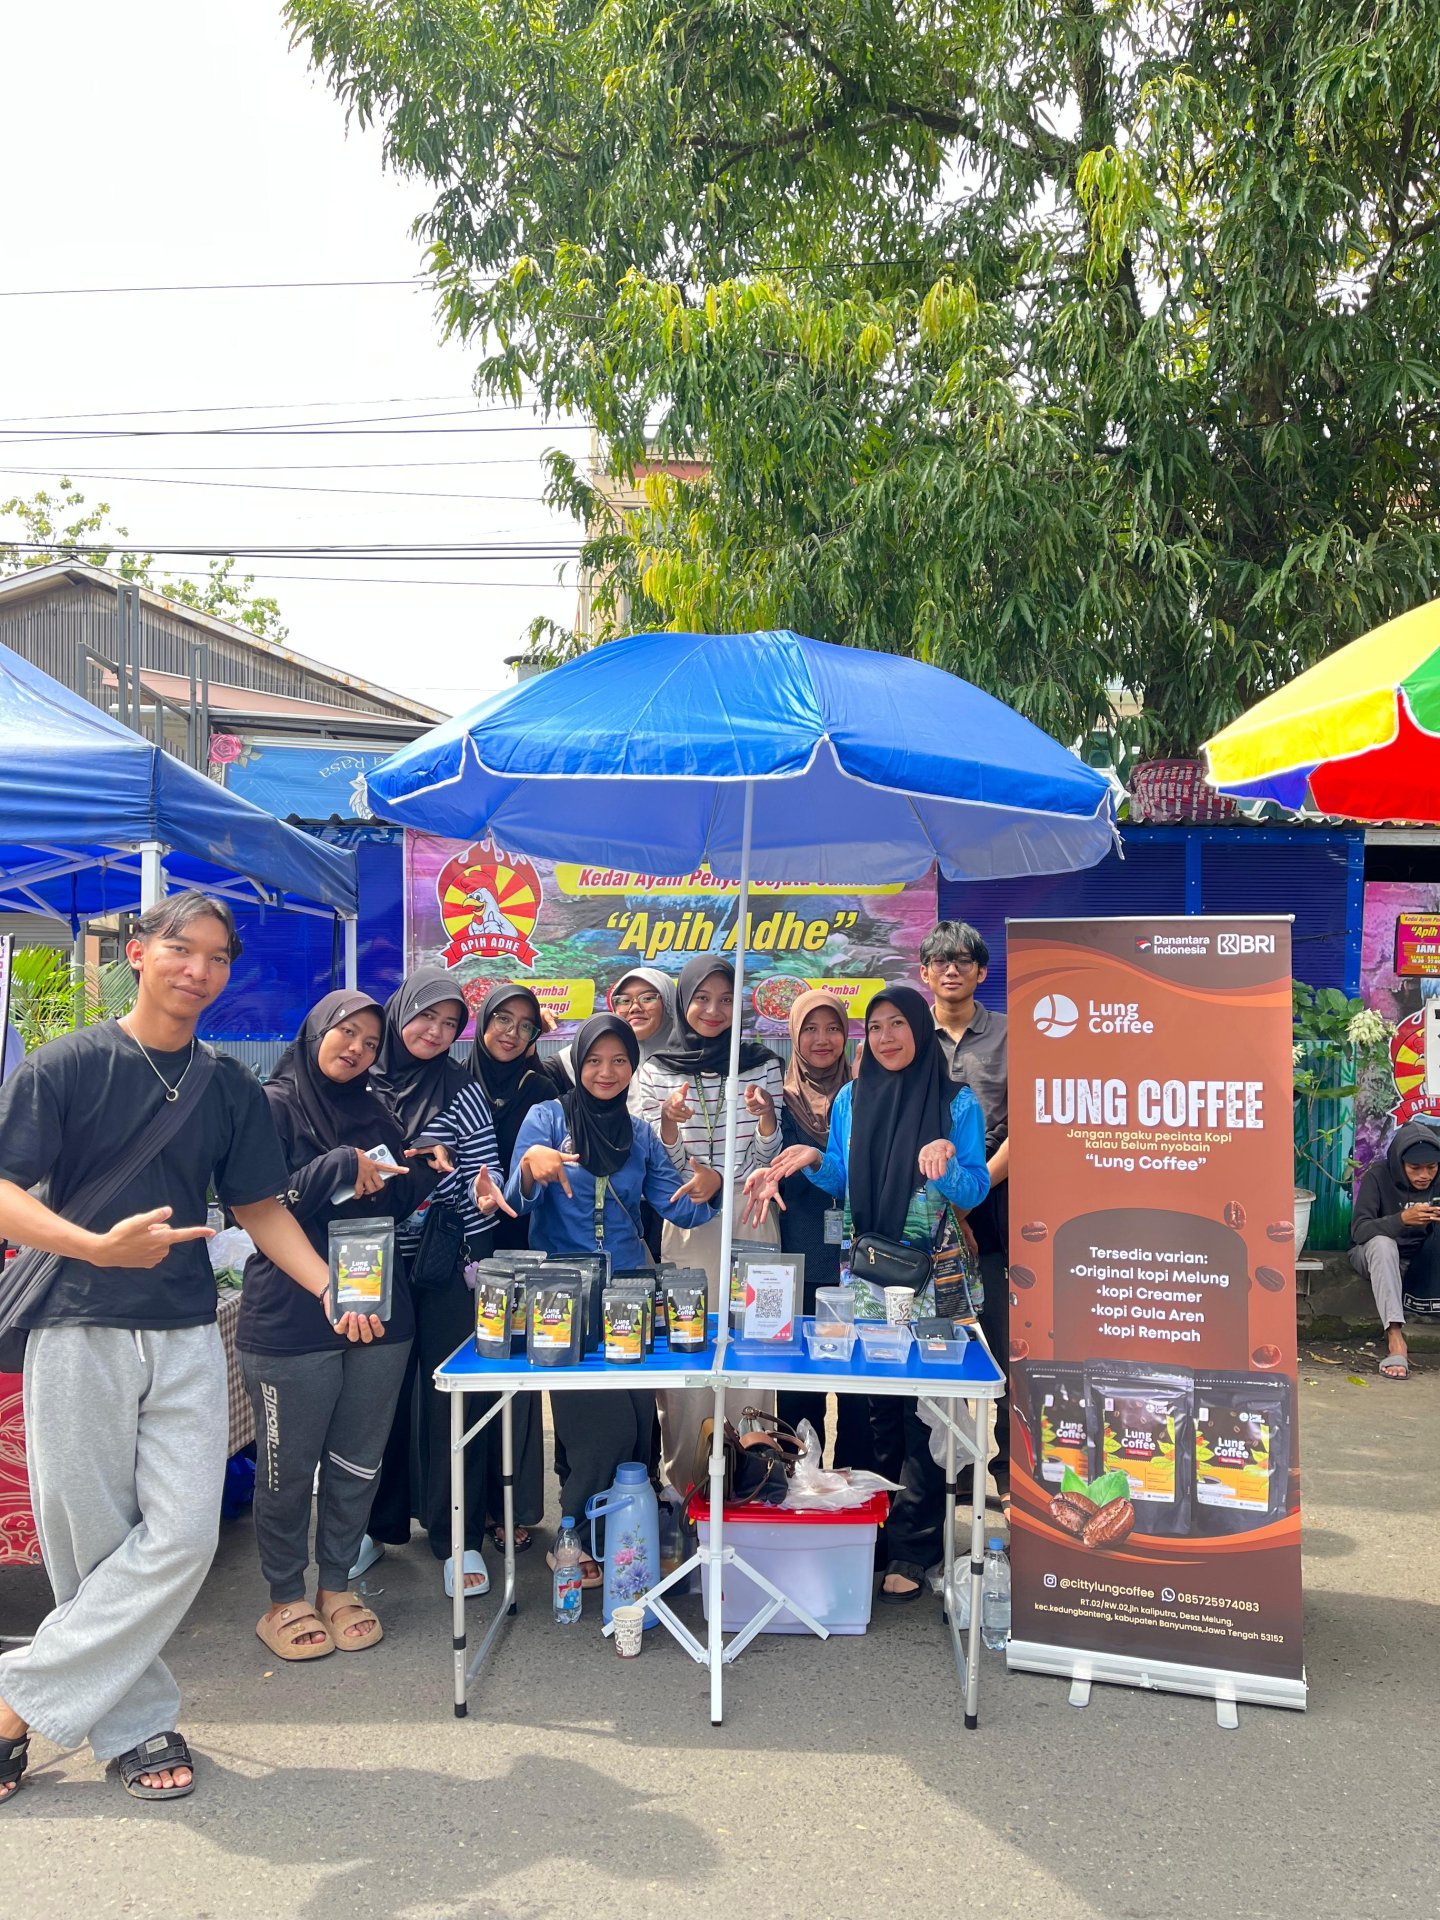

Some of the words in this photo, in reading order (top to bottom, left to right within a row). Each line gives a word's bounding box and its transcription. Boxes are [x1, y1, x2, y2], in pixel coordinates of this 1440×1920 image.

[578, 868, 629, 887] Kedai
[688, 868, 741, 891] Peny
[460, 937, 488, 953] APIH
[490, 936, 521, 952] ADHE
[606, 911, 714, 961] “Apih
[1153, 935, 1210, 945] Danantara
[1240, 934, 1275, 953] BRI
[1153, 944, 1207, 955] Indonesia
[1416, 944, 1436, 954] JAM
[538, 1000, 571, 1014] mangi
[1088, 1000, 1139, 1020] Lung
[1088, 1017, 1154, 1034] Coffee
[1035, 1078, 1128, 1126] LUNG
[1137, 1079, 1264, 1129] COFFEE
[1411, 1098, 1437, 1112] APIH
[1066, 1128, 1112, 1141] Jangan
[1115, 1131, 1153, 1144] ngaku
[1155, 1131, 1202, 1144] pecinta
[1204, 1132, 1232, 1144] Kopi
[1085, 1138, 1118, 1150] kalau
[1120, 1139, 1158, 1151] belum
[1160, 1141, 1210, 1154] nyobain
[1085, 1153, 1135, 1172] “Lung
[1138, 1155, 1207, 1172] Coffee”
[1089, 1246, 1153, 1262] Tersedia
[1155, 1249, 1208, 1265] varian:
[1137, 1267, 1169, 1284] kopi
[1172, 1270, 1230, 1288] Melung
[1136, 1287, 1203, 1303] Creamer
[1130, 1305, 1166, 1321] Gula
[1168, 1309, 1205, 1323] Aren
[1138, 1325, 1201, 1343] Rempah
[1056, 1428, 1087, 1440] Coffee
[1060, 1420, 1084, 1433] Lung
[1125, 1428, 1153, 1442] Lung
[1121, 1437, 1156, 1450] Coffee
[1218, 1436, 1246, 1451] Lung
[1214, 1446, 1249, 1459] Coffee
[1059, 1577, 1155, 1599] @cittylungcoffee
[1177, 1592, 1260, 1613] 085725974083
[1140, 1605, 1179, 1619] kaliputra,
[1179, 1612, 1200, 1622] Desa
[1201, 1615, 1234, 1627] Melung,
[1114, 1613, 1158, 1627] kabupaten
[1227, 1628, 1259, 1641] Tengah
[1260, 1633, 1284, 1644] 53152
